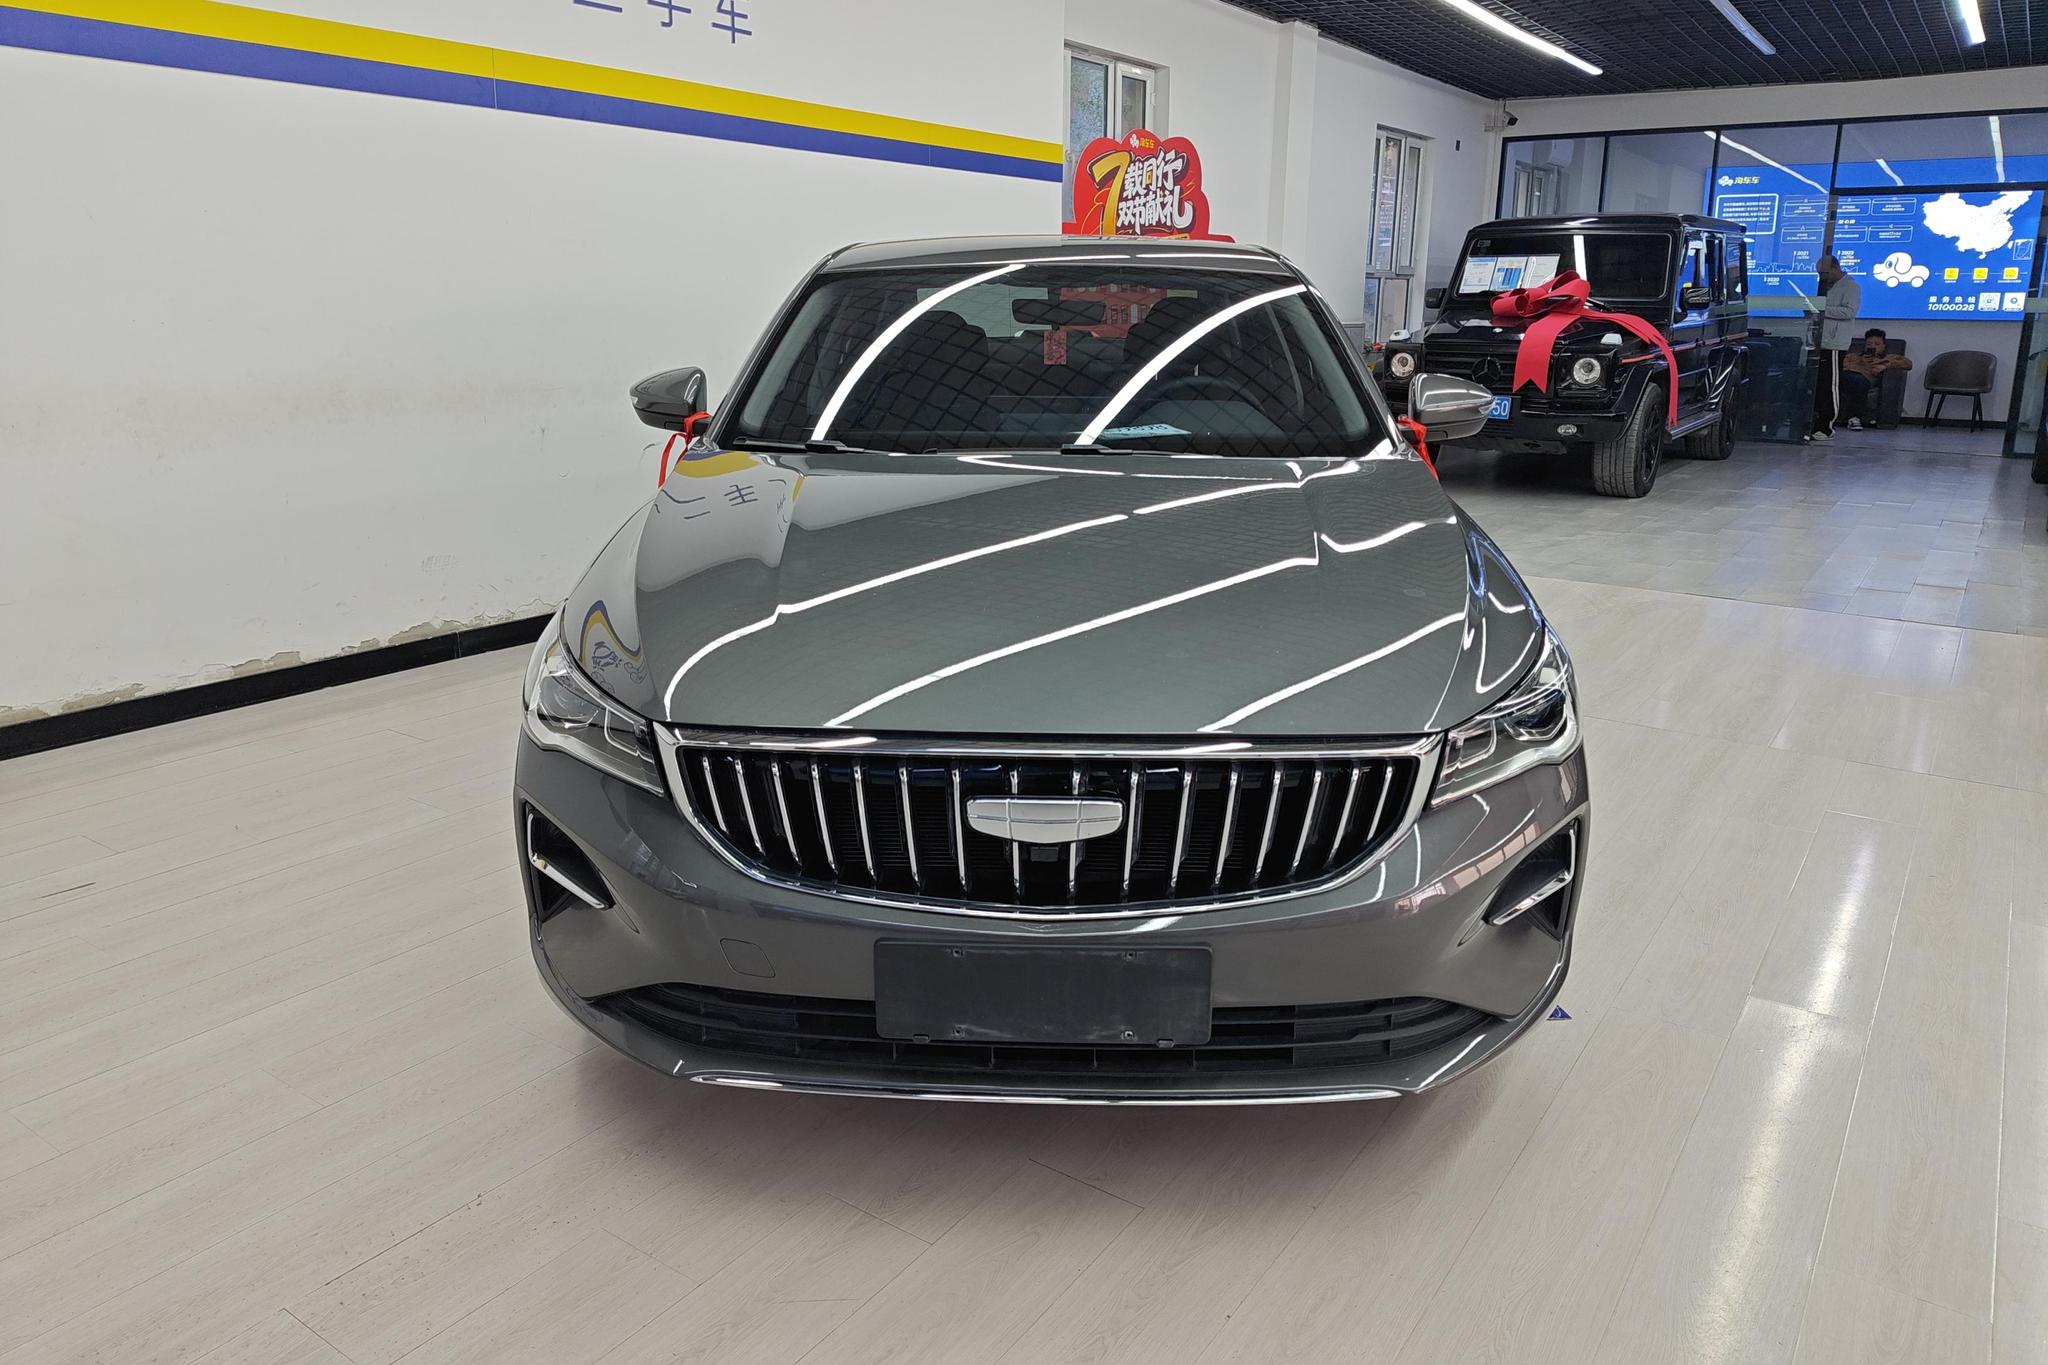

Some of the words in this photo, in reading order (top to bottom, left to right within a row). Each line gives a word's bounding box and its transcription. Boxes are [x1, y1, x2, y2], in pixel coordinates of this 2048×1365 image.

[1092, 151, 1132, 236] 7
[1116, 186, 1194, 235] 双节献礼
[1928, 303, 1976, 311] 10100028
